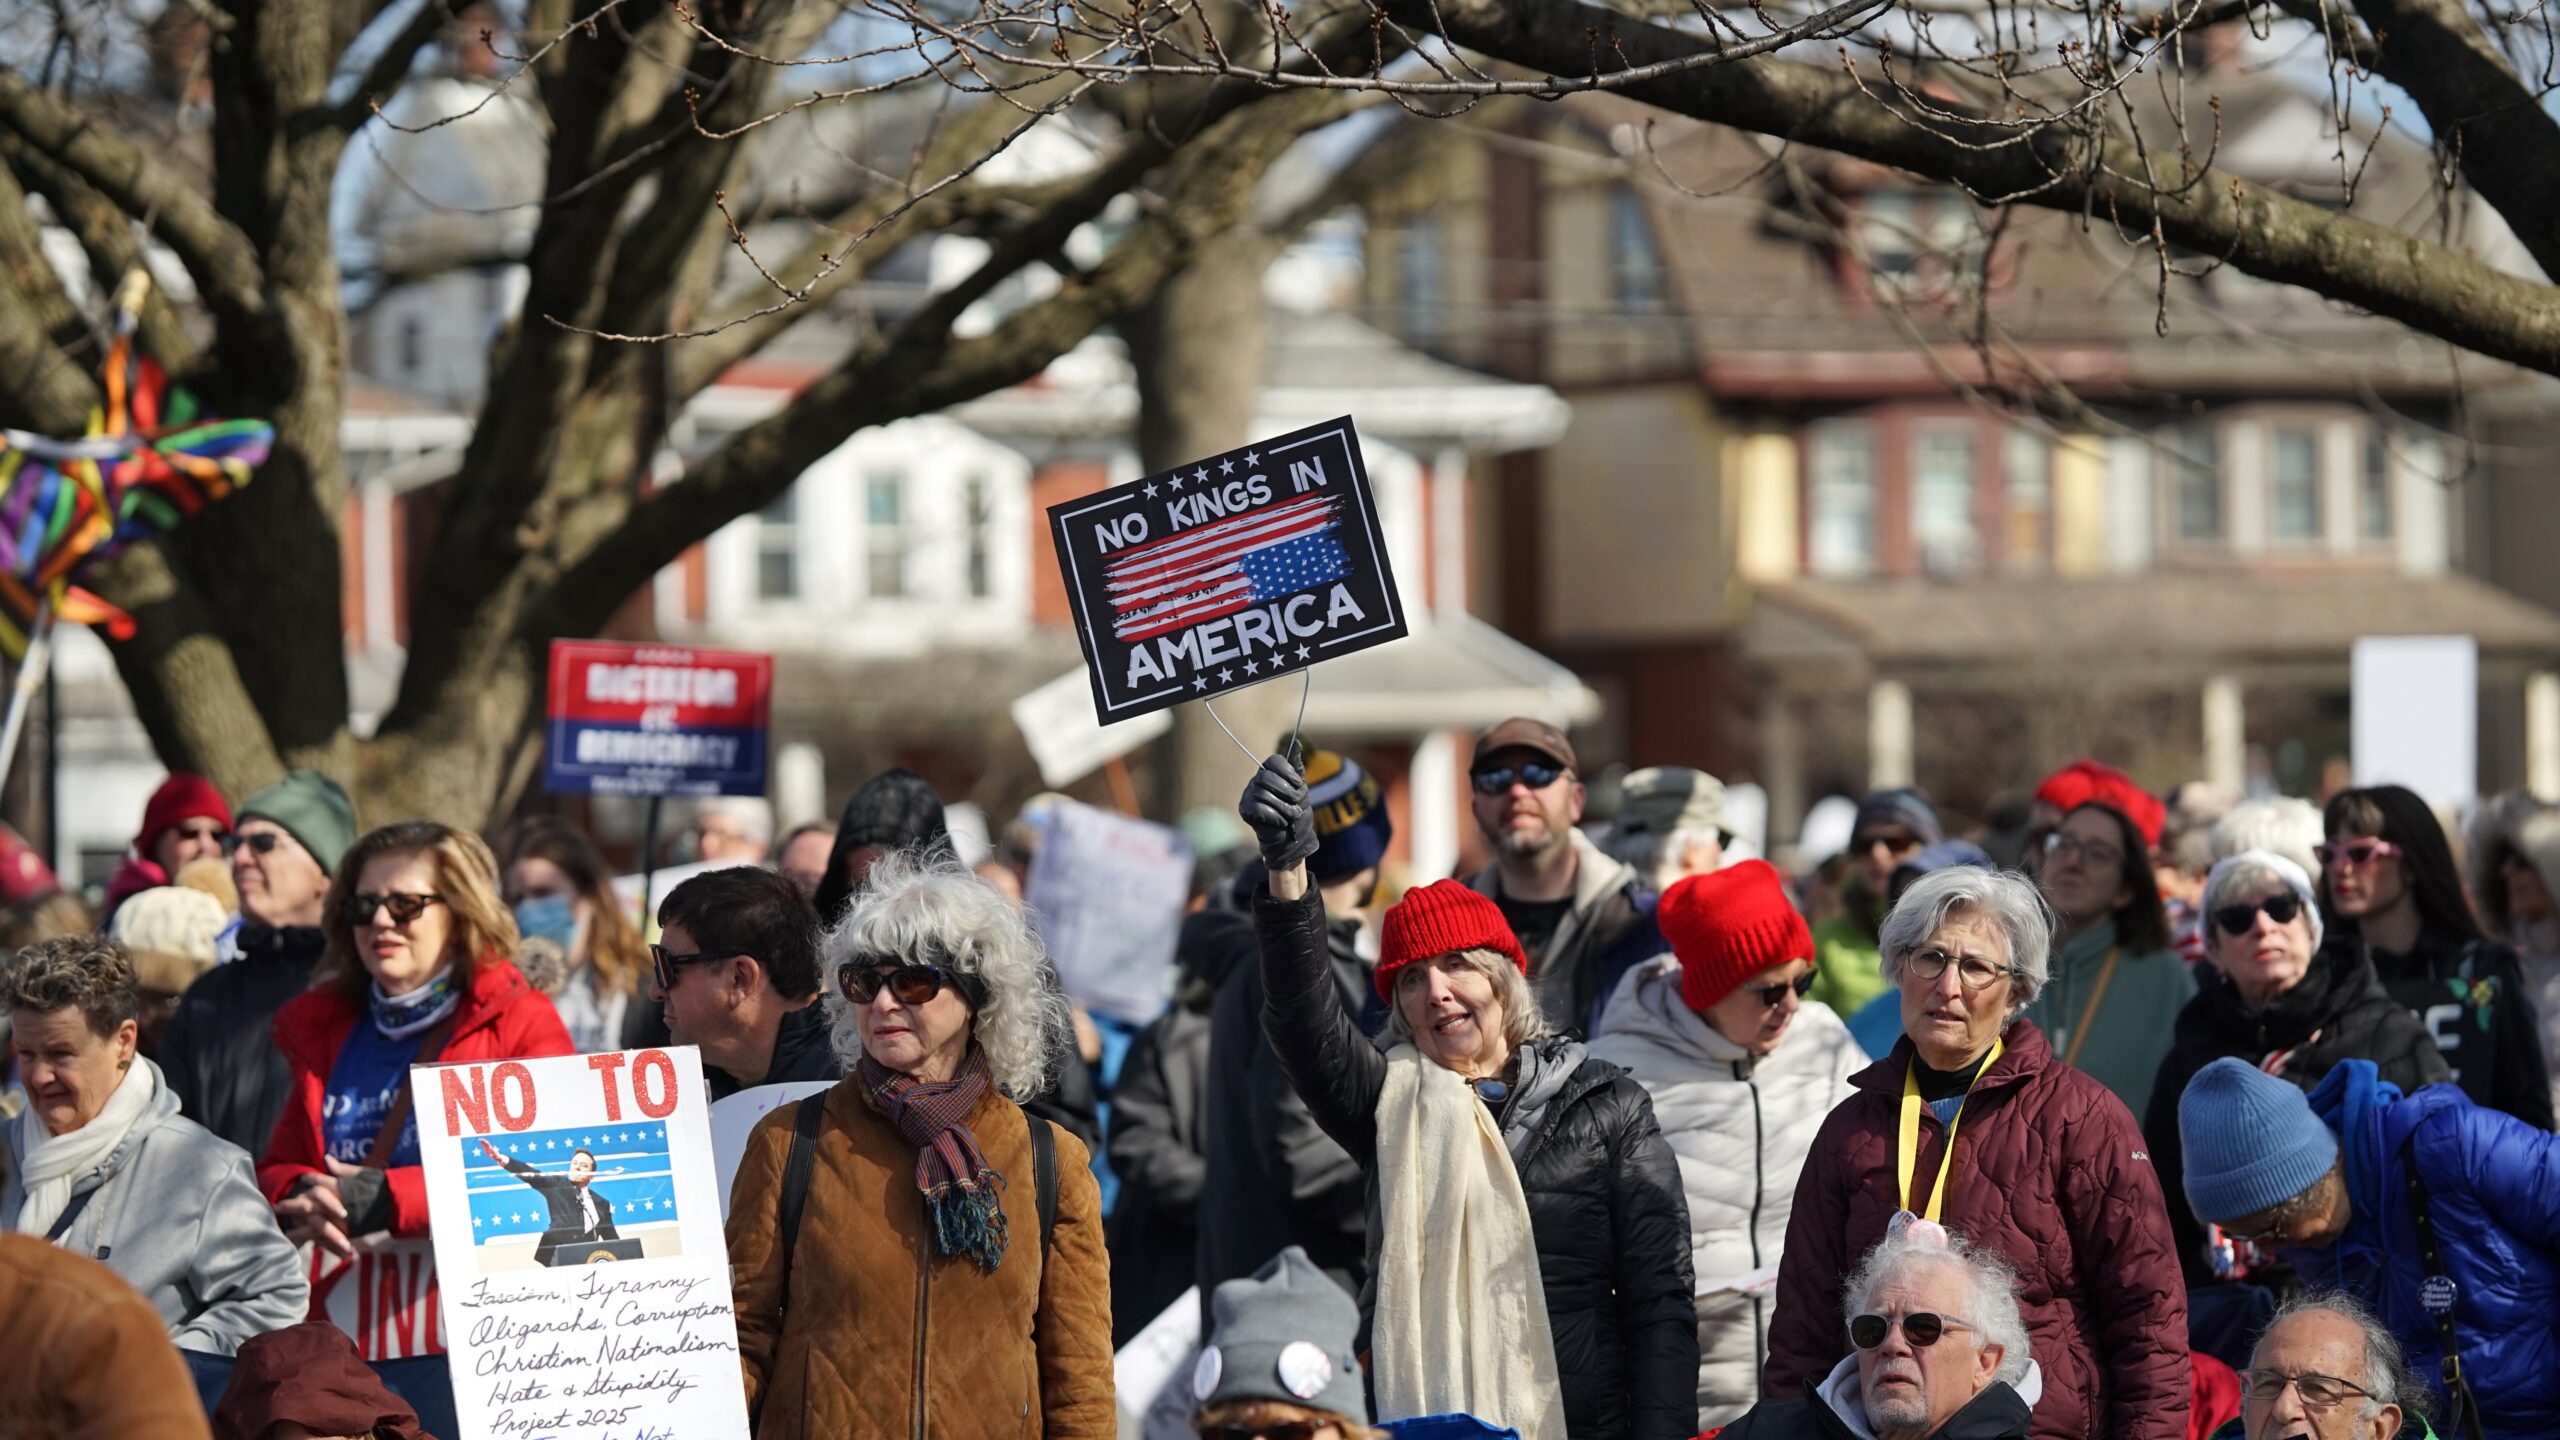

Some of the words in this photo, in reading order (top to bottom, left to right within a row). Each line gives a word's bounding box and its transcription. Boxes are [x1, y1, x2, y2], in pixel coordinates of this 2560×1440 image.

[1095, 513, 1149, 554] NO
[1166, 475, 1272, 531] KINGS
[1289, 455, 1327, 493] IN
[1127, 583, 1365, 688] AMERICA
[586, 663, 738, 706] DICTATOR
[577, 730, 738, 767] DEMOCRACY
[440, 1062, 537, 1137] NO
[588, 1050, 679, 1122] TO
[577, 1270, 710, 1308] Tyranny
[469, 1307, 607, 1348] Oligarchs,
[616, 1301, 733, 1333] Corruption
[476, 1342, 592, 1377] Christian
[597, 1331, 737, 1366] Nationalism
[487, 1380, 551, 1407] Hate
[583, 1367, 698, 1403] Stupidity
[490, 1408, 571, 1440] Project
[577, 1405, 642, 1427] 2025
